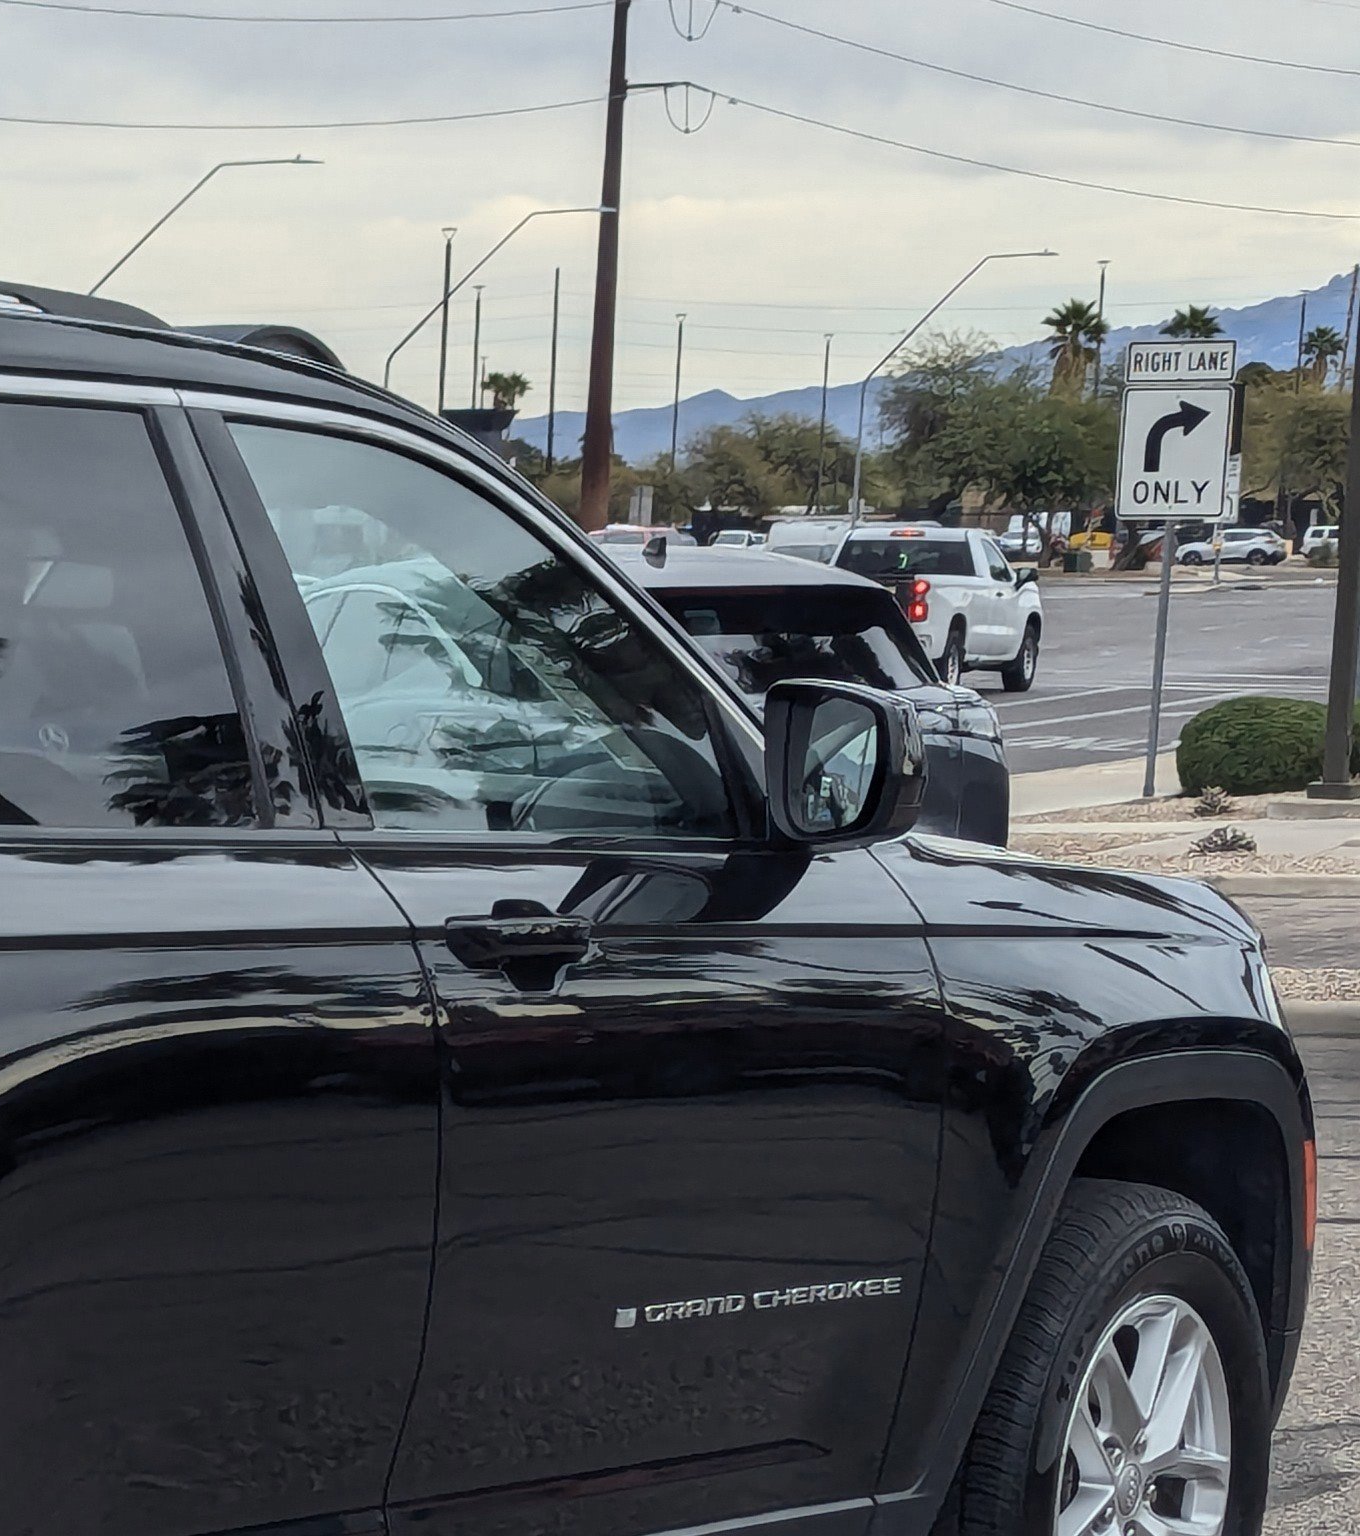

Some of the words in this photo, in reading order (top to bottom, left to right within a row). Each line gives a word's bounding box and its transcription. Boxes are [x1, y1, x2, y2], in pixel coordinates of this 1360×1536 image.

[1134, 352, 1181, 373] RIGHT
[1188, 351, 1229, 371] LANE
[1133, 480, 1210, 504] ONLY
[644, 1295, 746, 1323] GRAND
[753, 1277, 903, 1310] CHEROKEE
